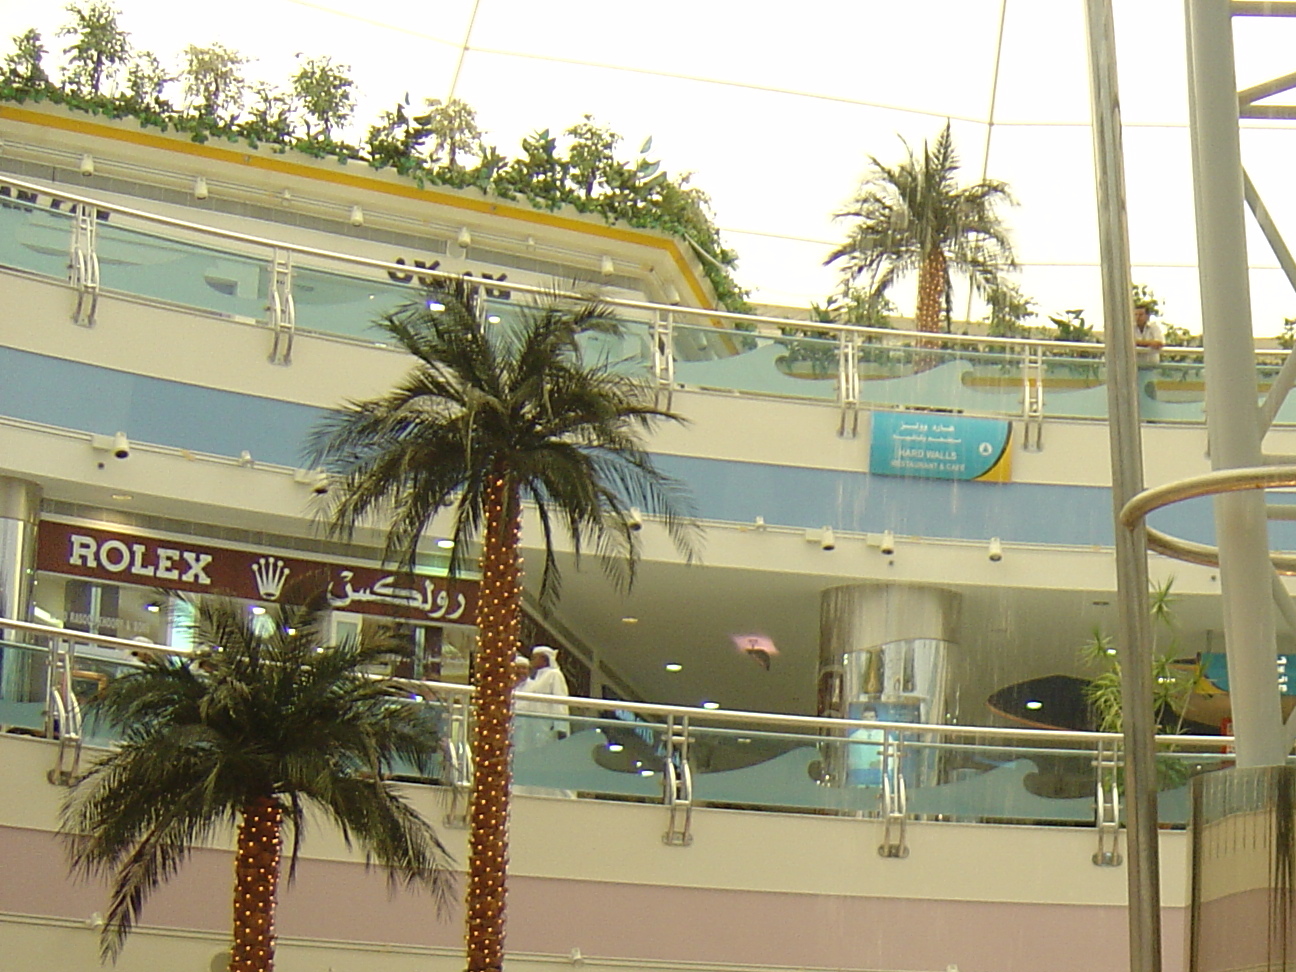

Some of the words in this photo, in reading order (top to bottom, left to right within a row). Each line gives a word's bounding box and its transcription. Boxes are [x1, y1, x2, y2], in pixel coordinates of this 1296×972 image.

[926, 450, 957, 460] WALLS
[69, 534, 213, 585] ROLEX
[326, 570, 467, 620] رولكس
